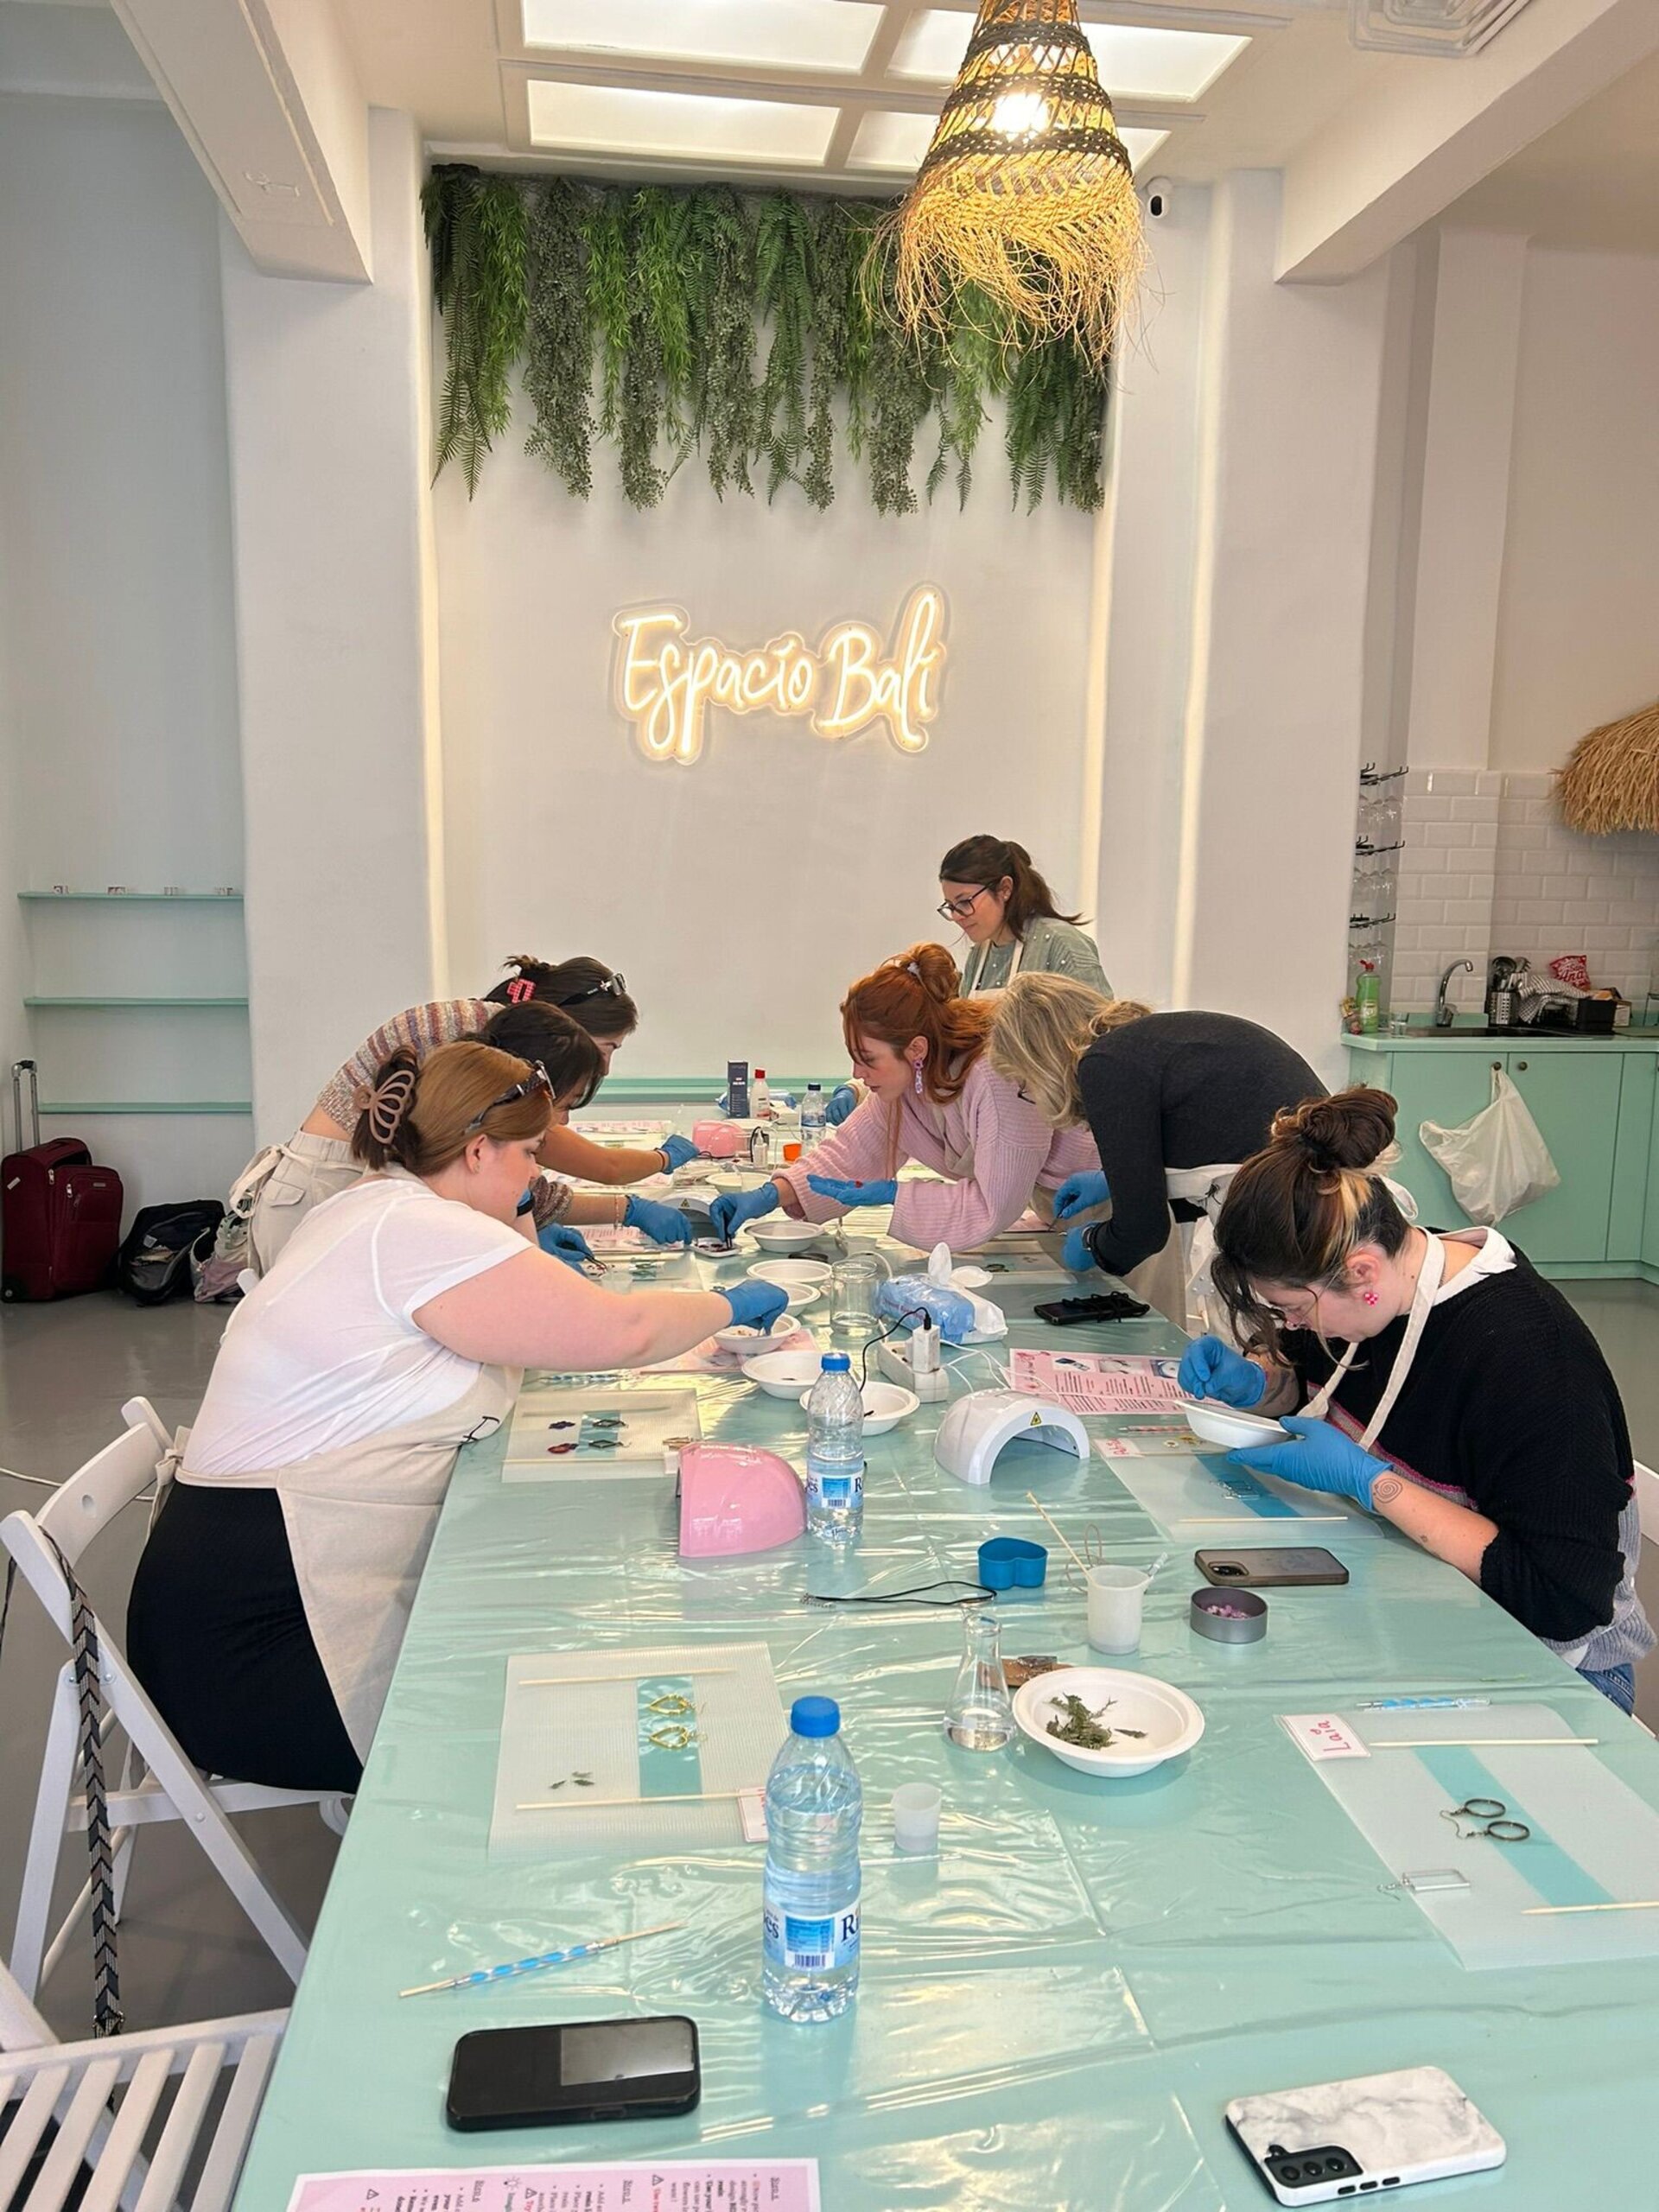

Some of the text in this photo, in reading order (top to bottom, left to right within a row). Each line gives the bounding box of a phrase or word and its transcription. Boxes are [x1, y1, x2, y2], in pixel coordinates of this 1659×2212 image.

[620, 593, 942, 755] Espacio Bali
[1309, 1719, 1351, 1752] Laia
